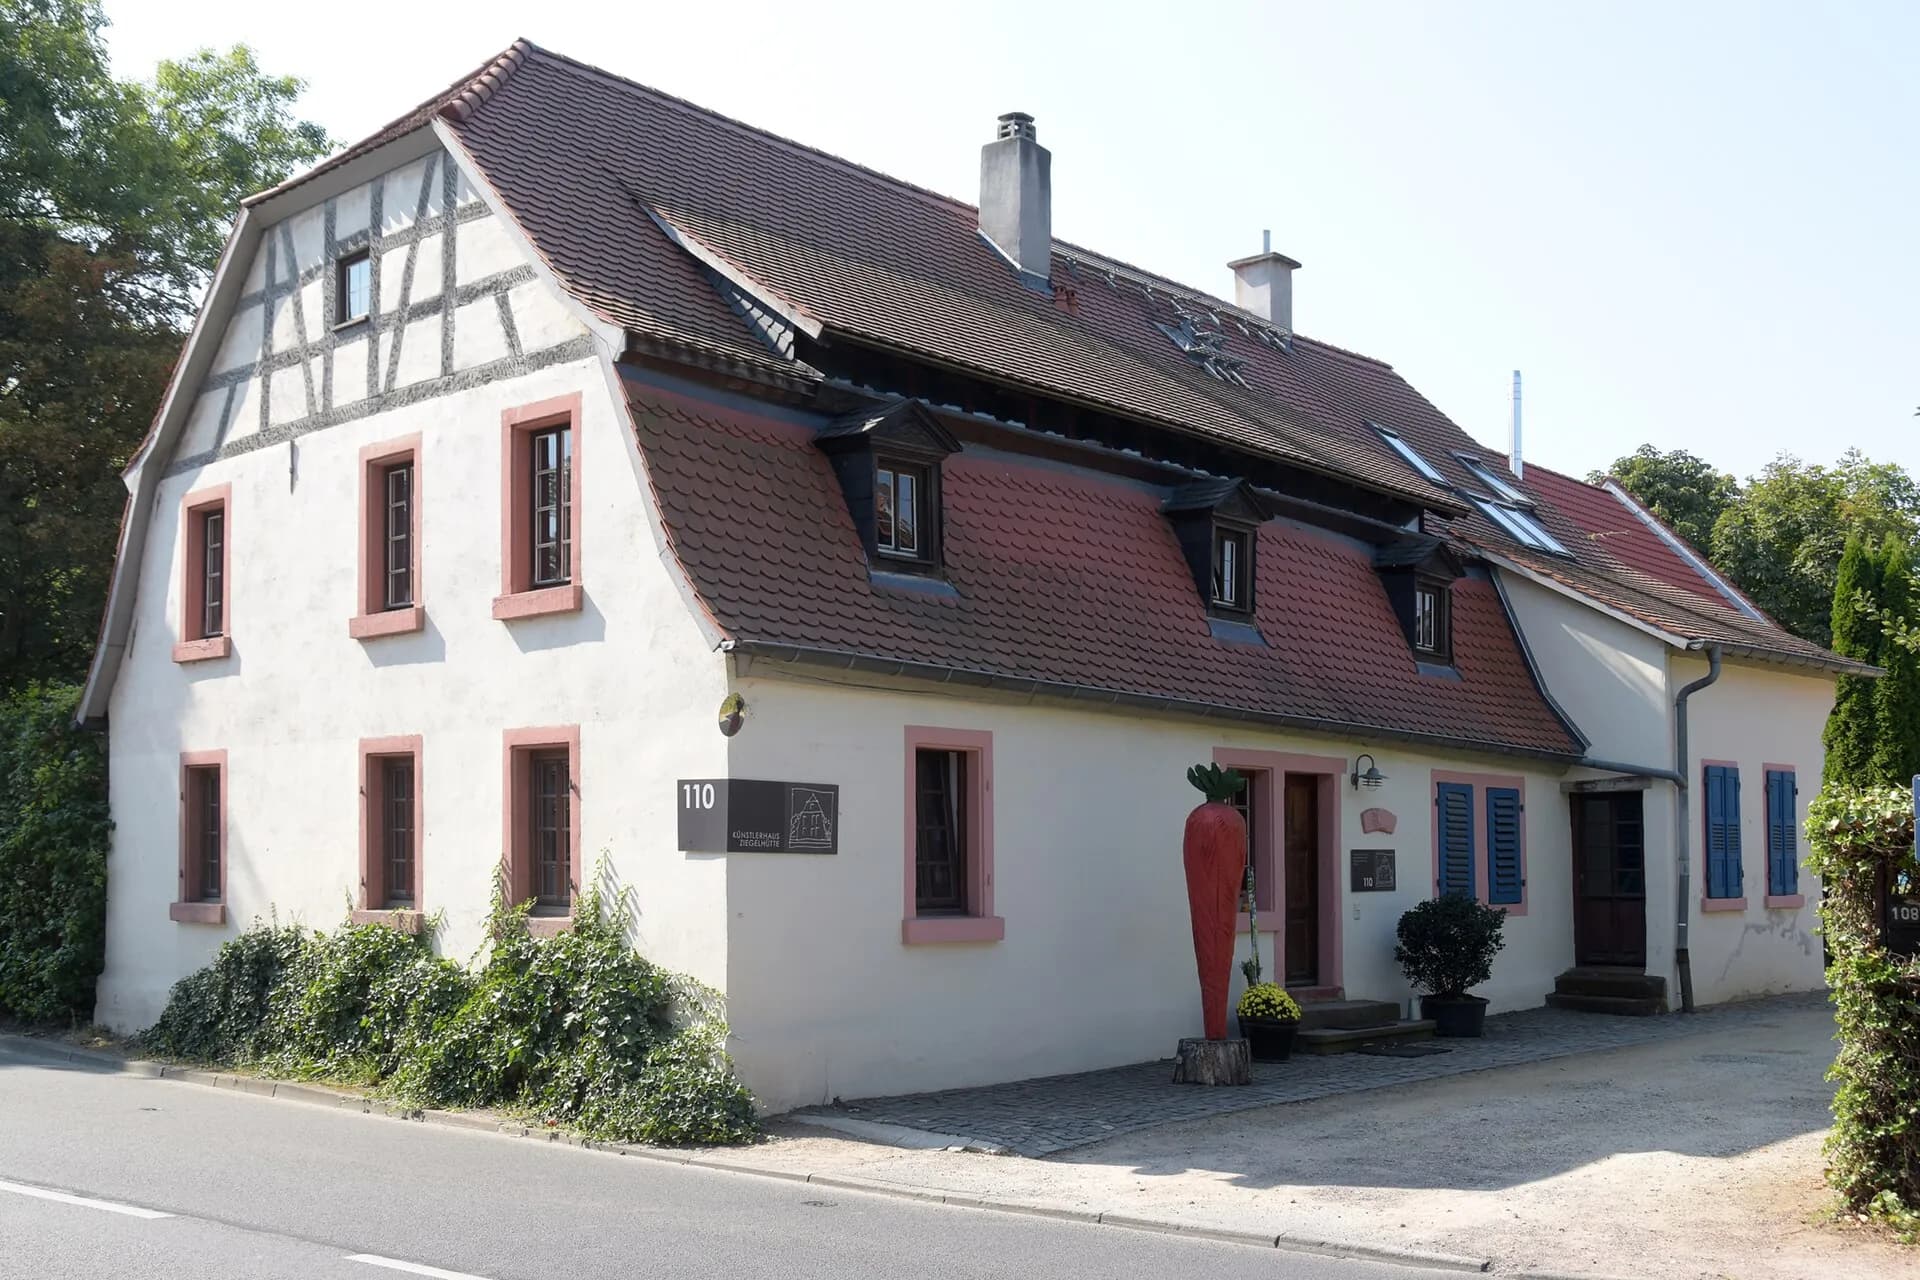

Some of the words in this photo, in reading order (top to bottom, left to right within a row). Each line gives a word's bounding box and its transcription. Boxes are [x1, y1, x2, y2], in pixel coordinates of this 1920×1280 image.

[683, 784, 715, 809] 110
[732, 830, 780, 839] KÜNSTLERHAUS
[739, 839, 780, 848] ZIEGELHÜTTE
[1363, 877, 1374, 887] 110
[1891, 906, 1919, 920] 108
